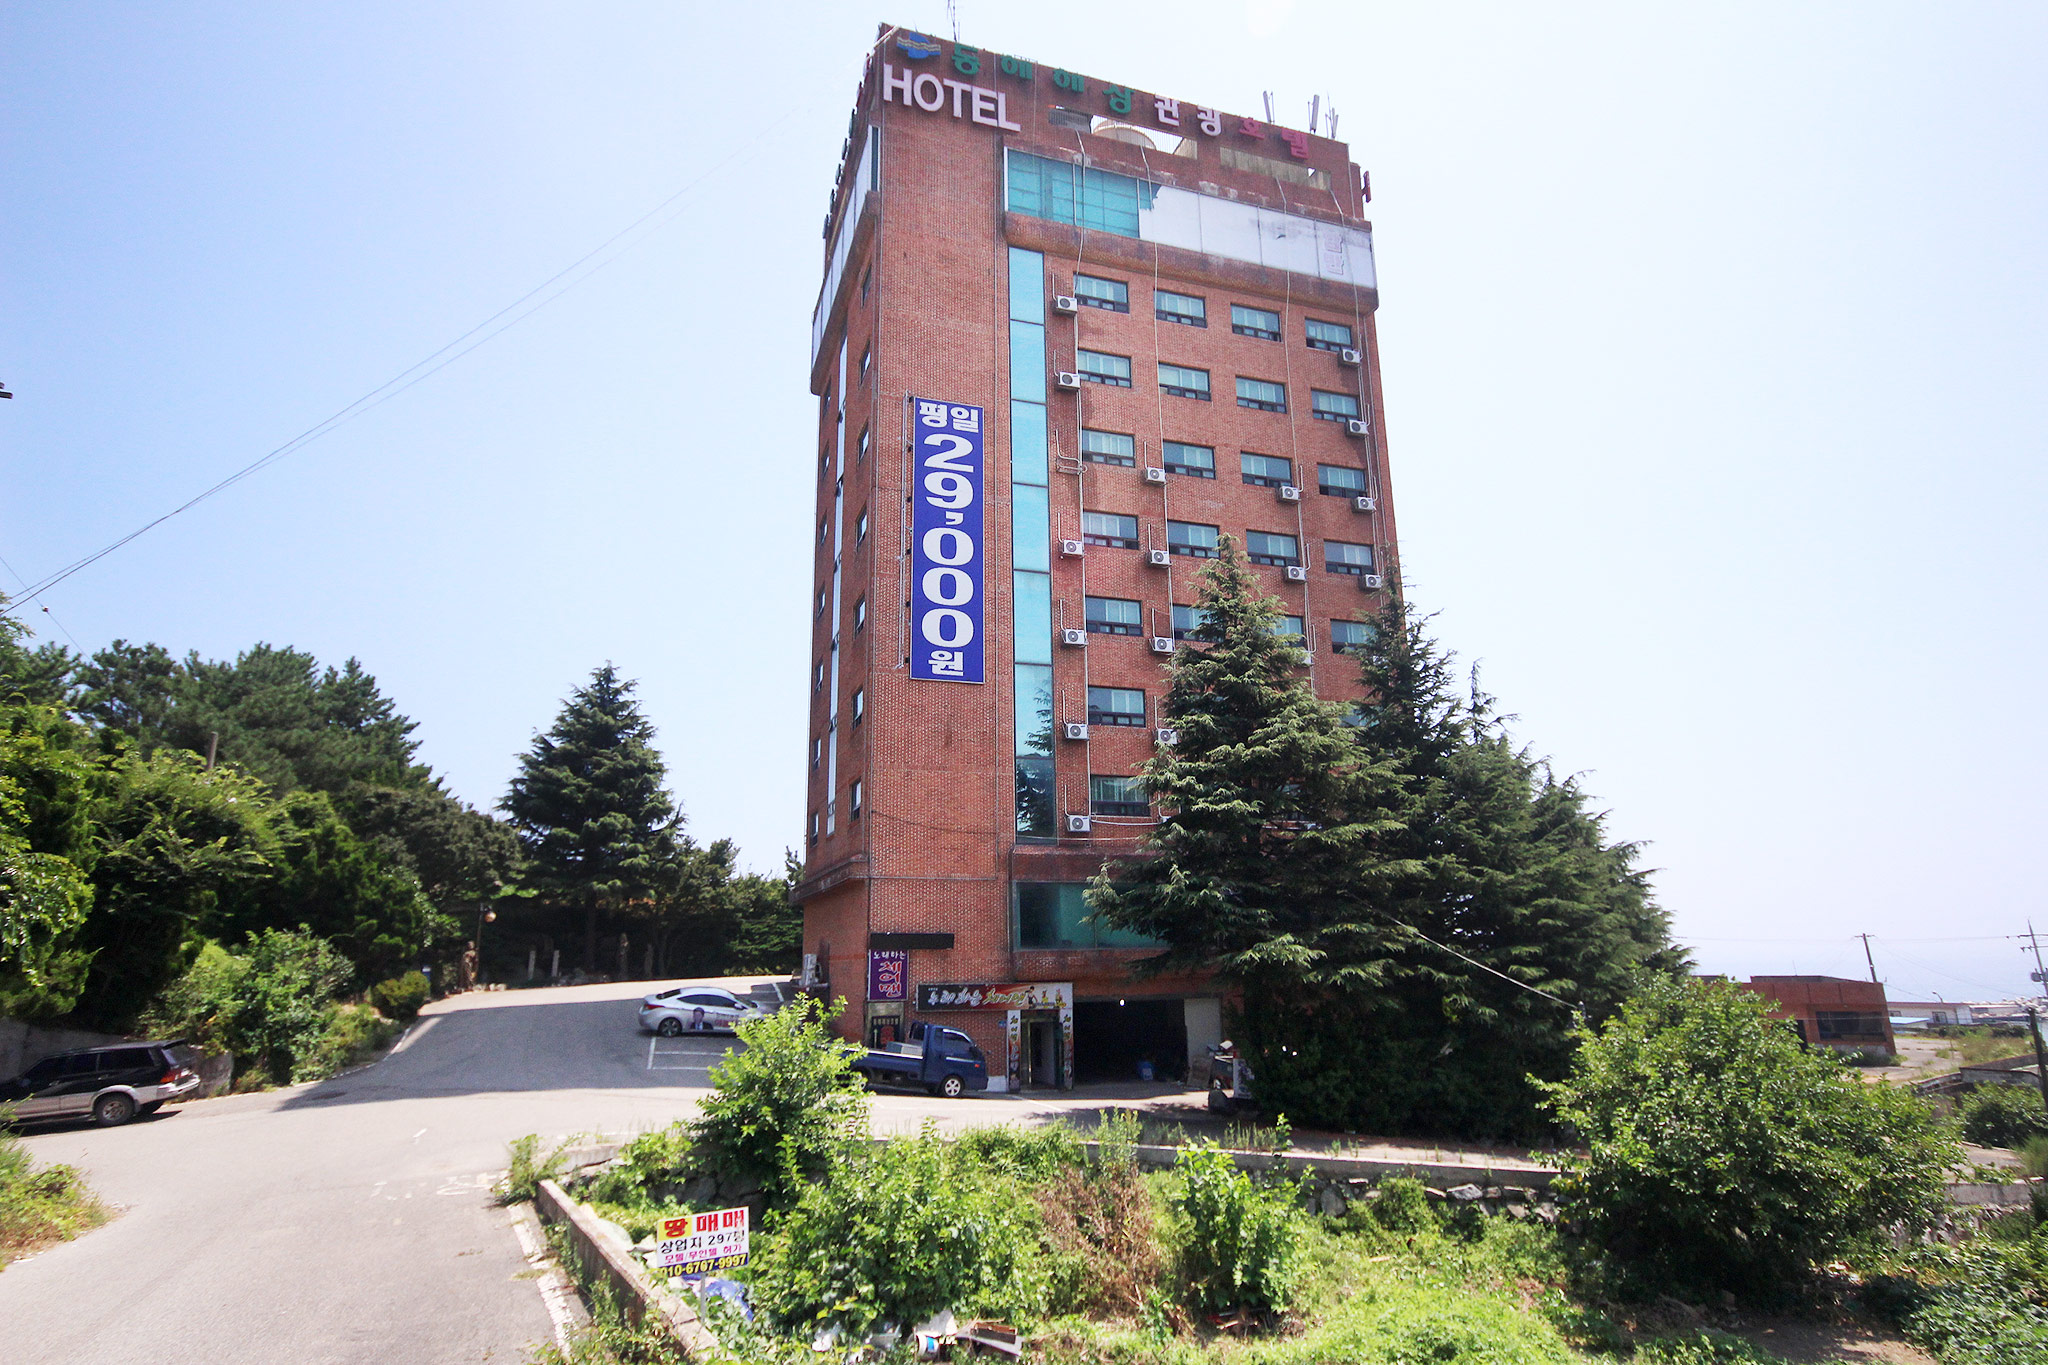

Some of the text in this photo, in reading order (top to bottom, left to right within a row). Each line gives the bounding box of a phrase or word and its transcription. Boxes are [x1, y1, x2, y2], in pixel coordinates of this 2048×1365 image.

[883, 63, 1021, 132] HOTEL
[919, 401, 979, 433] 평일
[873, 950, 907, 960] 노래하는
[664, 1218, 688, 1238] 땅
[660, 1236, 702, 1254] 상업지
[723, 1244, 742, 1254] 허가
